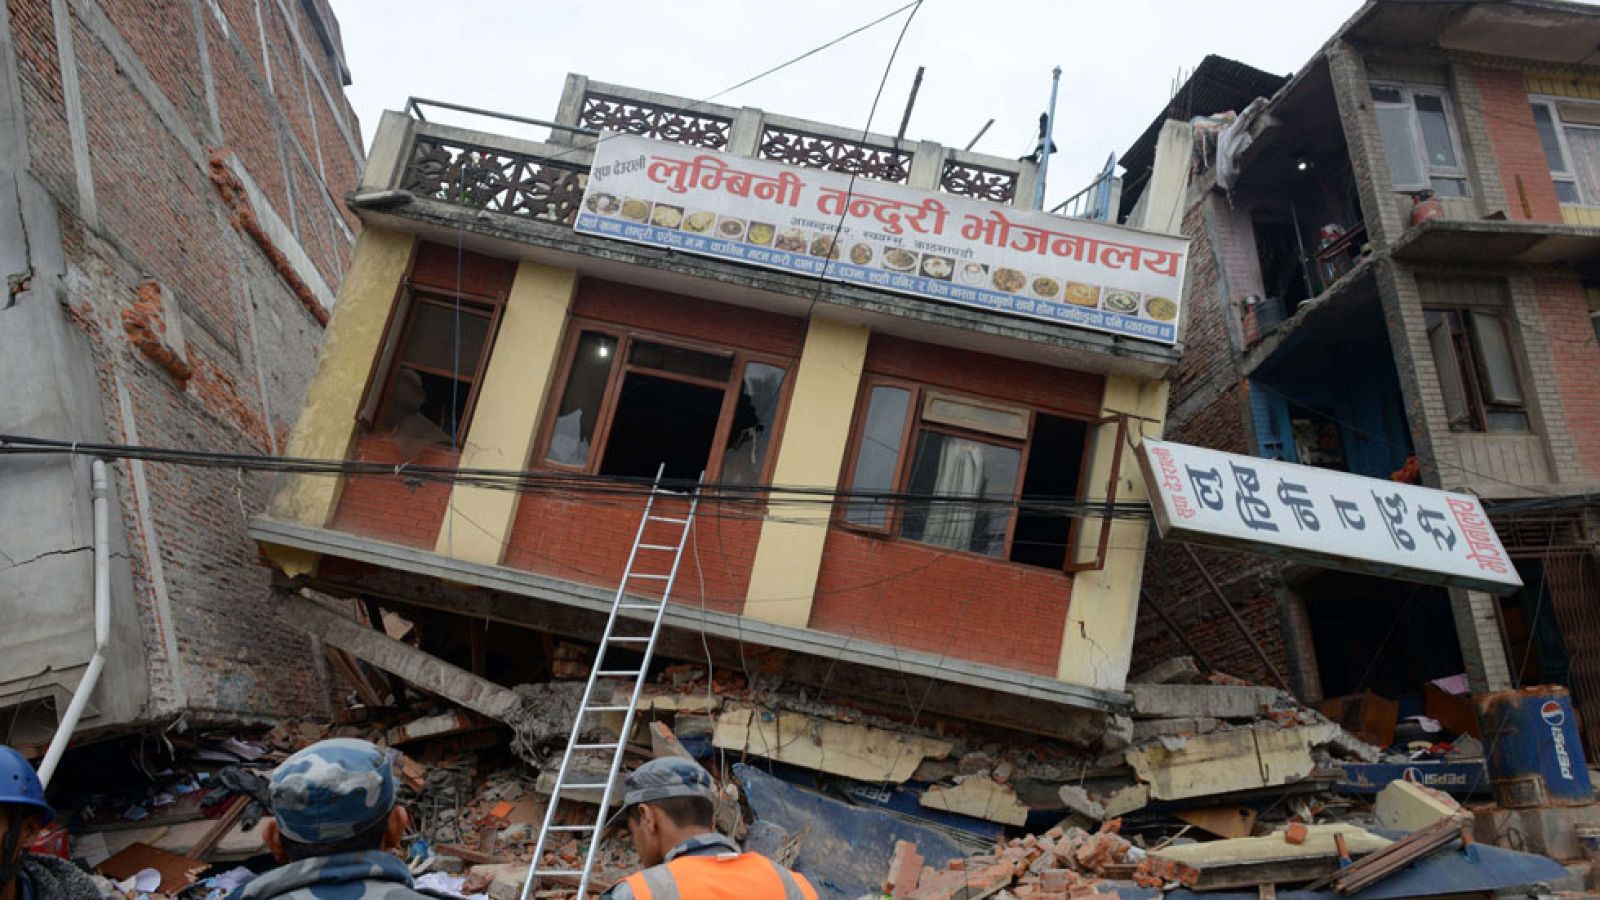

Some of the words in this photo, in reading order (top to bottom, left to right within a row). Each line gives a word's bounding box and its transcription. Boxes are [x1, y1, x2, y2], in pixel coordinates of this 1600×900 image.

[647, 154, 807, 207] लुम्बिनी
[817, 185, 949, 236] तन्दुरी
[961, 210, 1185, 278] भोजनालय
[1445, 496, 1508, 574] भोजनालय
[1551, 727, 1575, 780] PEPSI
